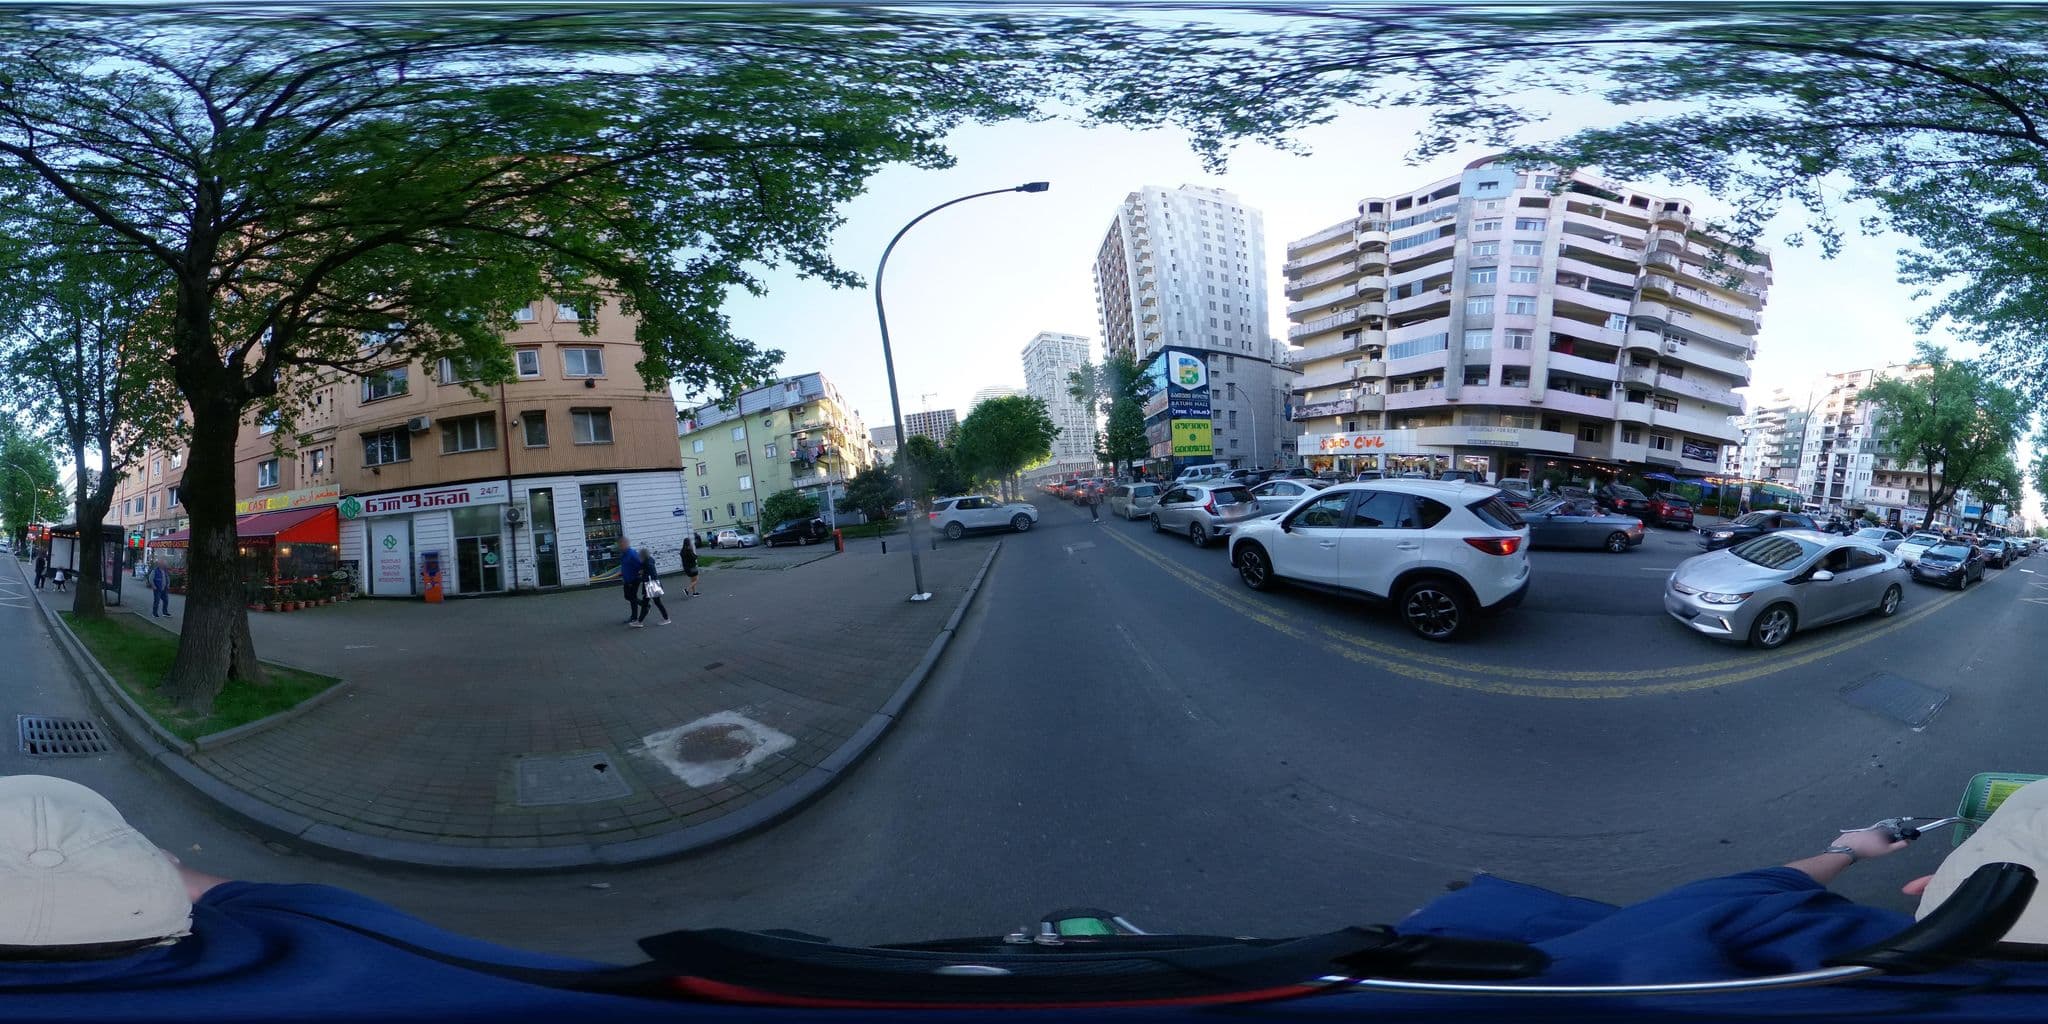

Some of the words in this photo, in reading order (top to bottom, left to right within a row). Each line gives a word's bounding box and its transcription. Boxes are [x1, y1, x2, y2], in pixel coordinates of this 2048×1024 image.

[1175, 445, 1211, 453] GOODWILL
[480, 486, 499, 496] 24/7
[365, 488, 470, 513] ნეოფარმი
